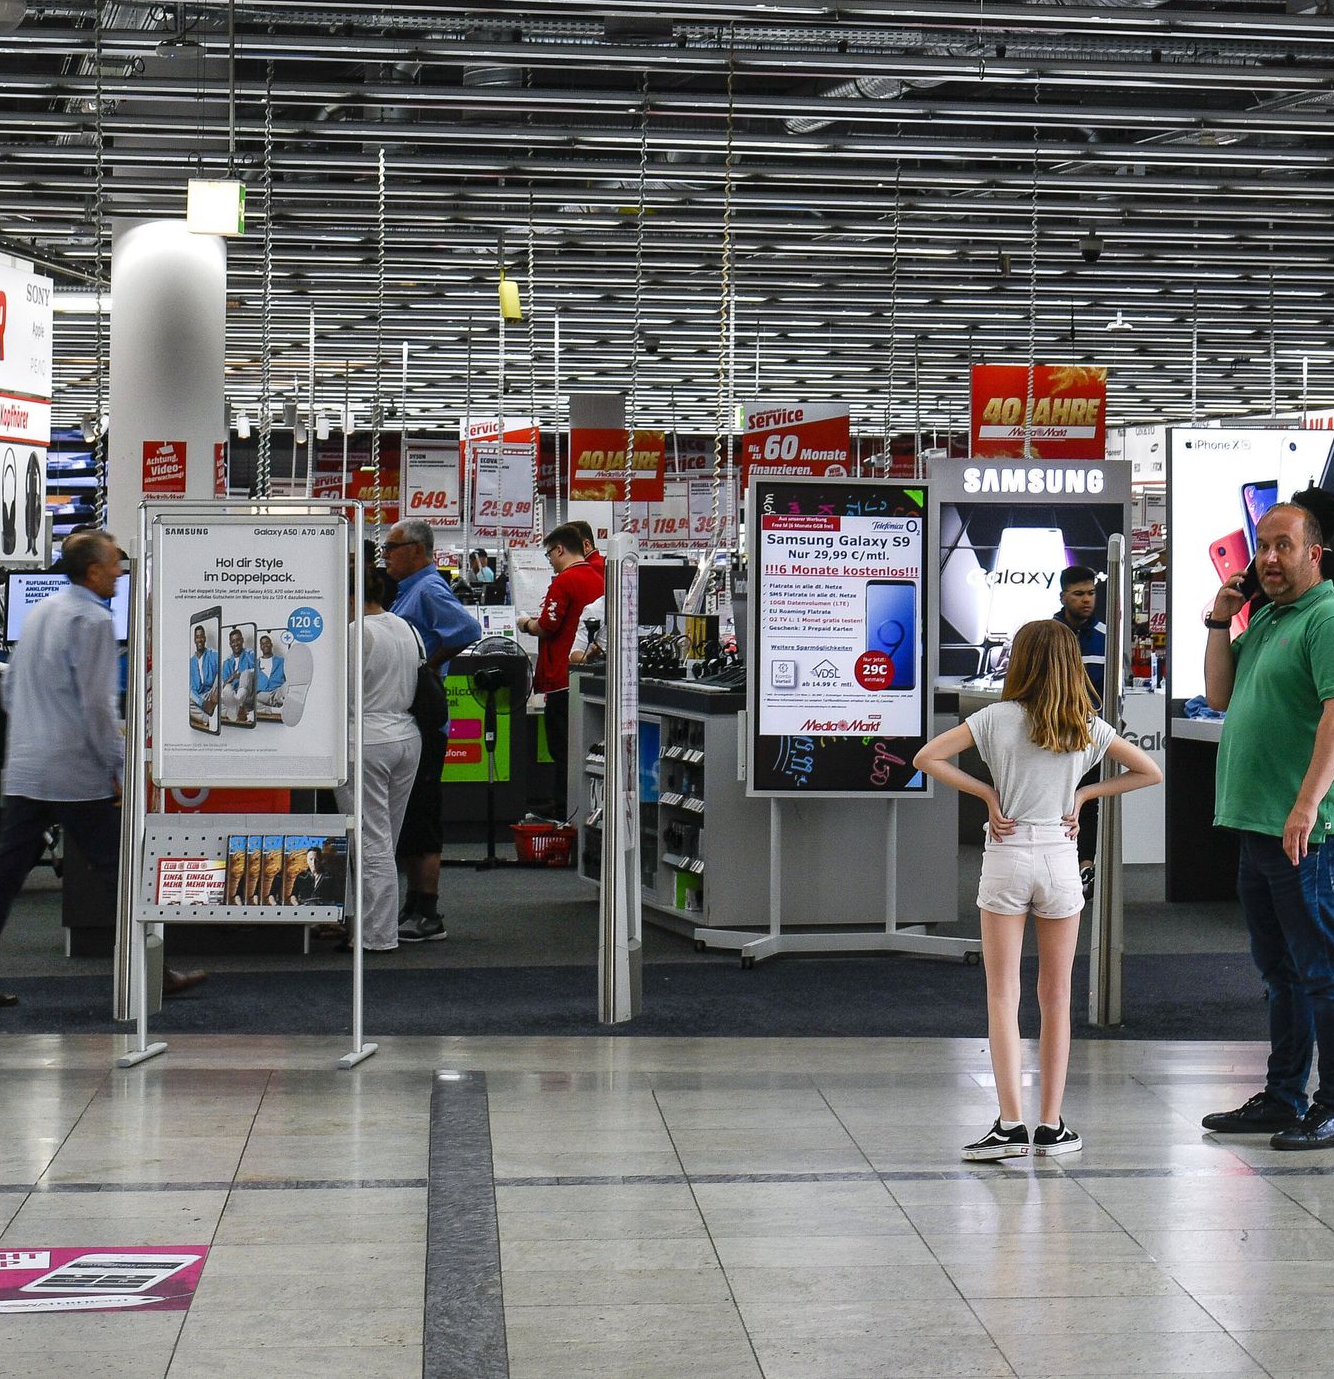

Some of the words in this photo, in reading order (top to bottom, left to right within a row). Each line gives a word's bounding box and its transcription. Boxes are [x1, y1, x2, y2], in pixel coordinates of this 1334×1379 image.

[26, 283, 50, 306] SONY
[0, 403, 29, 432] Kopfhörer
[982, 397, 1021, 425] 40
[748, 409, 803, 430] Service
[748, 444, 760, 453] Bis
[764, 435, 799, 461] 60
[1194, 439, 1230, 450] iPhone
[1232, 439, 1240, 450] X
[146, 453, 178, 466] Achtung,
[578, 450, 603, 469] 40
[800, 448, 847, 461] Monate
[151, 464, 183, 476] Video-
[748, 463, 813, 475] finanzieren.
[144, 471, 184, 484] überwachung!
[963, 467, 1104, 494] SAMSUNG
[410, 490, 458, 509] 649.-
[165, 528, 209, 536] SAMSUNG
[254, 528, 282, 538] Galaxy
[767, 533, 834, 549] Samsung
[839, 535, 888, 550] Galaxy
[892, 536, 911, 548] S9
[788, 549, 811, 559] Nur
[814, 550, 848, 561] 29,99
[216, 557, 234, 568] Hol
[236, 557, 252, 568] dir
[255, 558, 284, 571] Style
[204, 571, 219, 582] im
[221, 572, 295, 584] Doppelpack.
[792, 565, 839, 576] Monate
[843, 566, 919, 577] kostenlos!!!
[290, 616, 311, 628] 120
[313, 616, 321, 628] €
[796, 644, 853, 652] Sparmöglichkeiten
[816, 668, 841, 679] VDSL
[862, 664, 888, 675] 29€
[800, 718, 838, 731] Media
[847, 719, 882, 731] Markt
[186, 873, 213, 881] EINFACH
